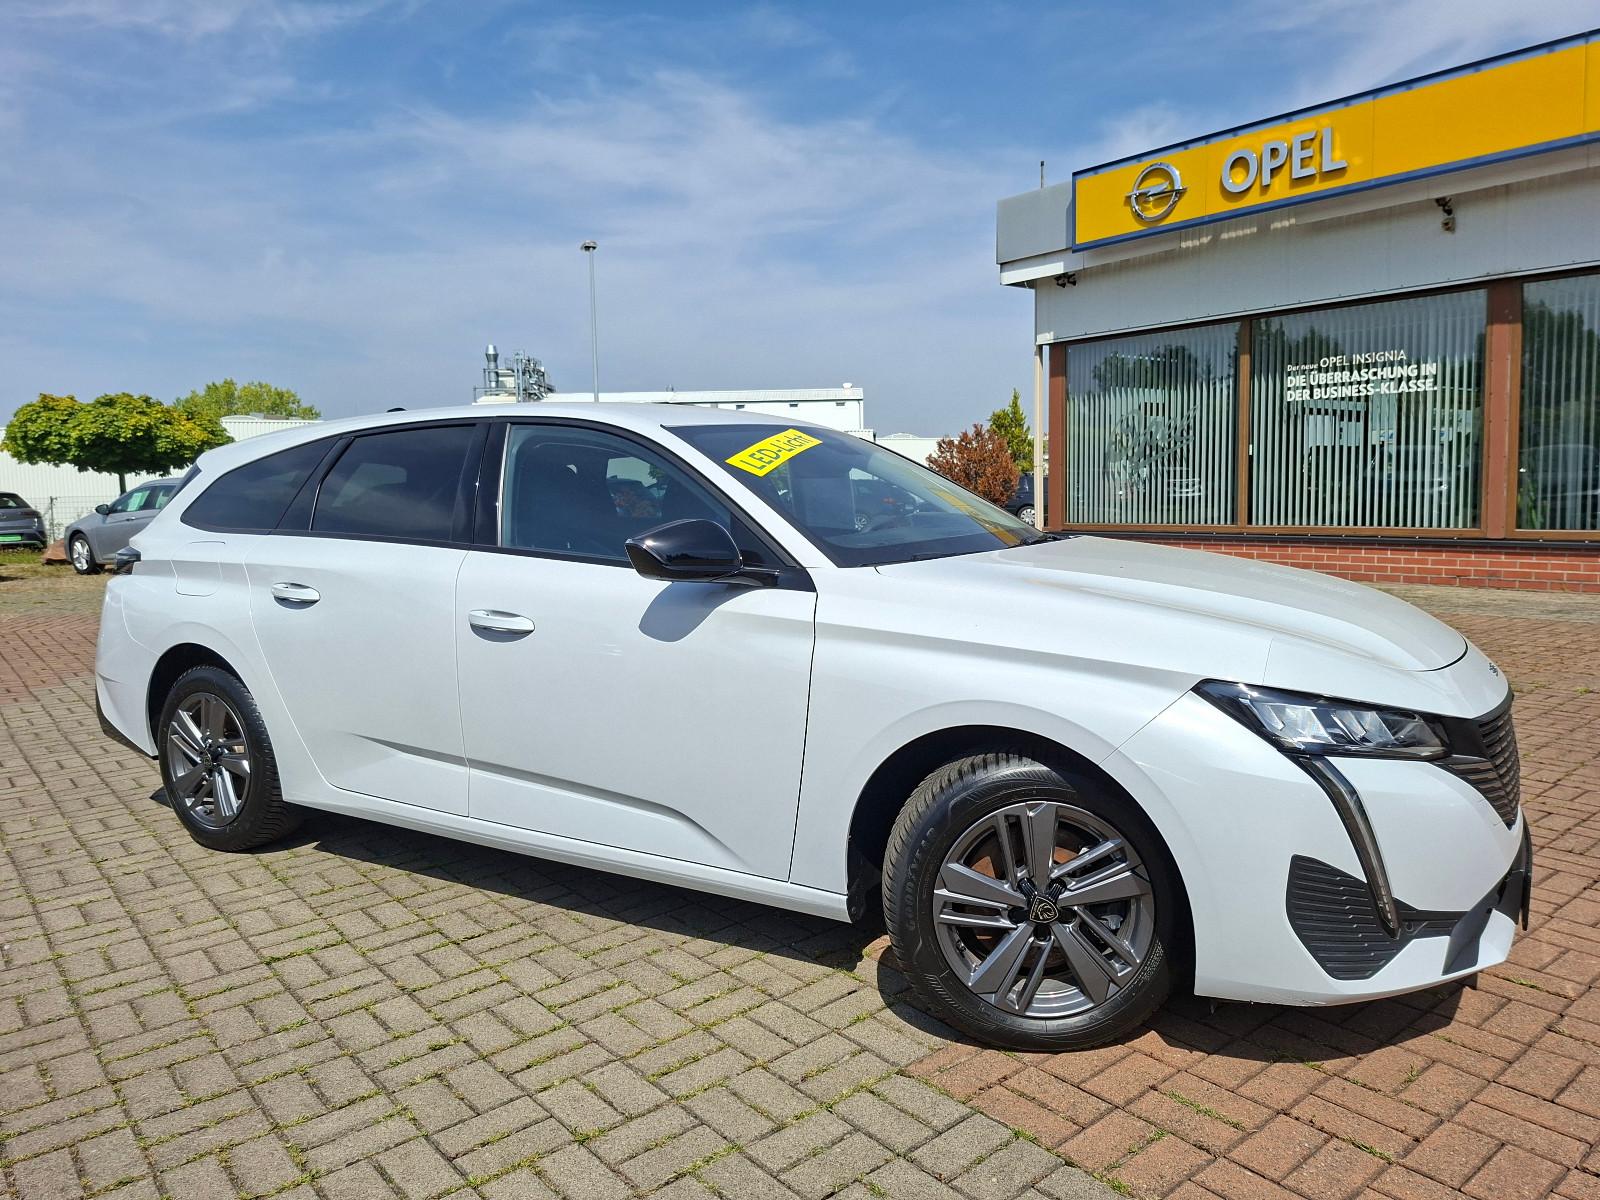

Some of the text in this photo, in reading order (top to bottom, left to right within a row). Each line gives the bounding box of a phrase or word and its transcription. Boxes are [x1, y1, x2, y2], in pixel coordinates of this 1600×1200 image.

[1222, 128, 1348, 193] OPEL
[1287, 364, 1300, 372] Der
[1320, 355, 1349, 368] OPEL
[1352, 350, 1407, 365] INSIGNIA
[1287, 363, 1437, 387] DIE ÜBERRASCHUNG IN
[1286, 378, 1438, 401] DER BUSINESS-KLASSE.
[740, 434, 814, 470] LED-Licht
